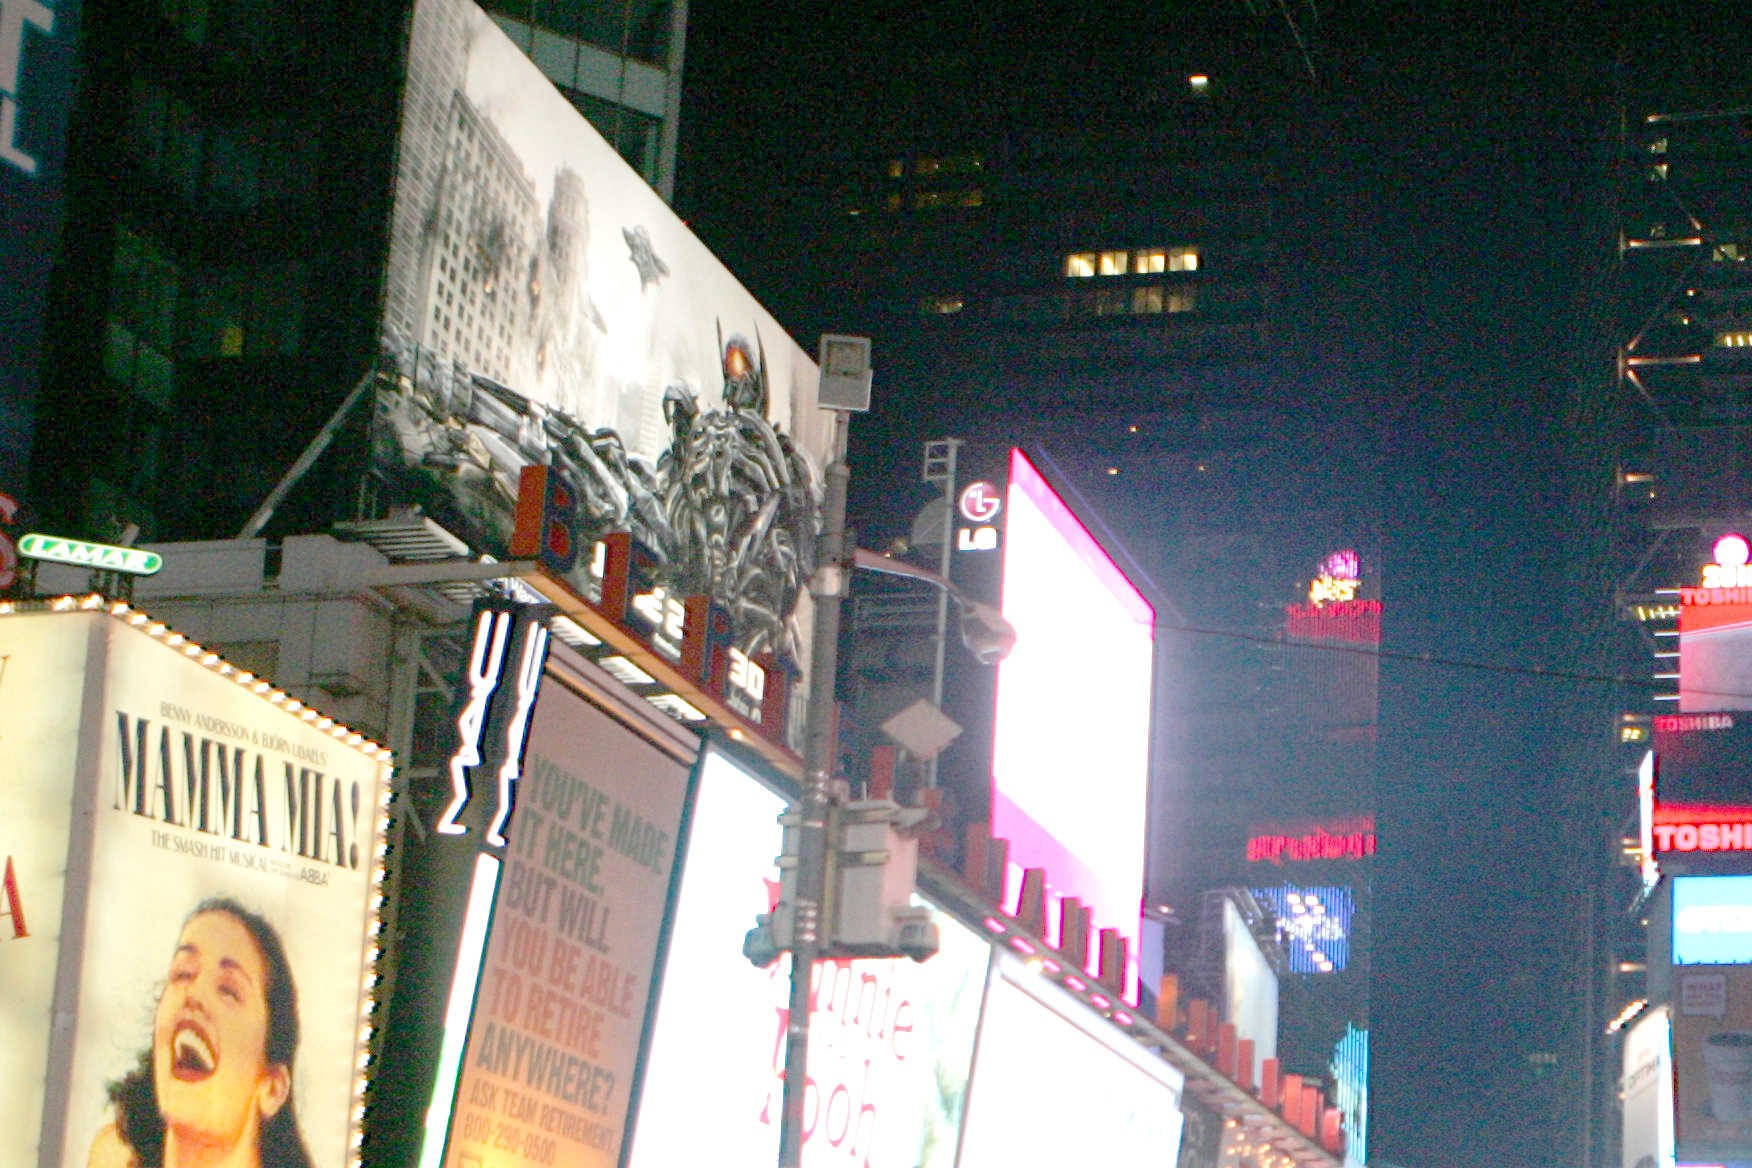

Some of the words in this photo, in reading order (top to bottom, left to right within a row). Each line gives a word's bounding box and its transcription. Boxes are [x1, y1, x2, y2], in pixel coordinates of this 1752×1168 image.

[33, 538, 148, 570] LAMAR
[196, 711, 249, 740] ANDERSSON
[1657, 714, 1735, 732] TOSHIBA
[113, 710, 271, 849] MAMMA
[282, 760, 361, 871] MIA!
[526, 754, 610, 841] YOU'VE
[609, 794, 669, 876] MADE
[151, 829, 170, 850] THE
[174, 834, 208, 860] SMASH
[210, 844, 226, 862] HIT
[517, 805, 543, 859] IT
[547, 821, 607, 896] HERE
[505, 860, 554, 923] BUT
[557, 879, 610, 954] WILL
[500, 911, 549, 971] YOU
[550, 939, 581, 990] BE
[580, 955, 638, 1020] ABLE
[488, 967, 522, 1024] TO
[522, 985, 606, 1060] RETIRE
[474, 1021, 617, 1117] ANYWHERE?
[469, 1079, 501, 1109] ASK
[502, 1086, 539, 1123] TEAM
[539, 1102, 617, 1152] RETIREMENT
